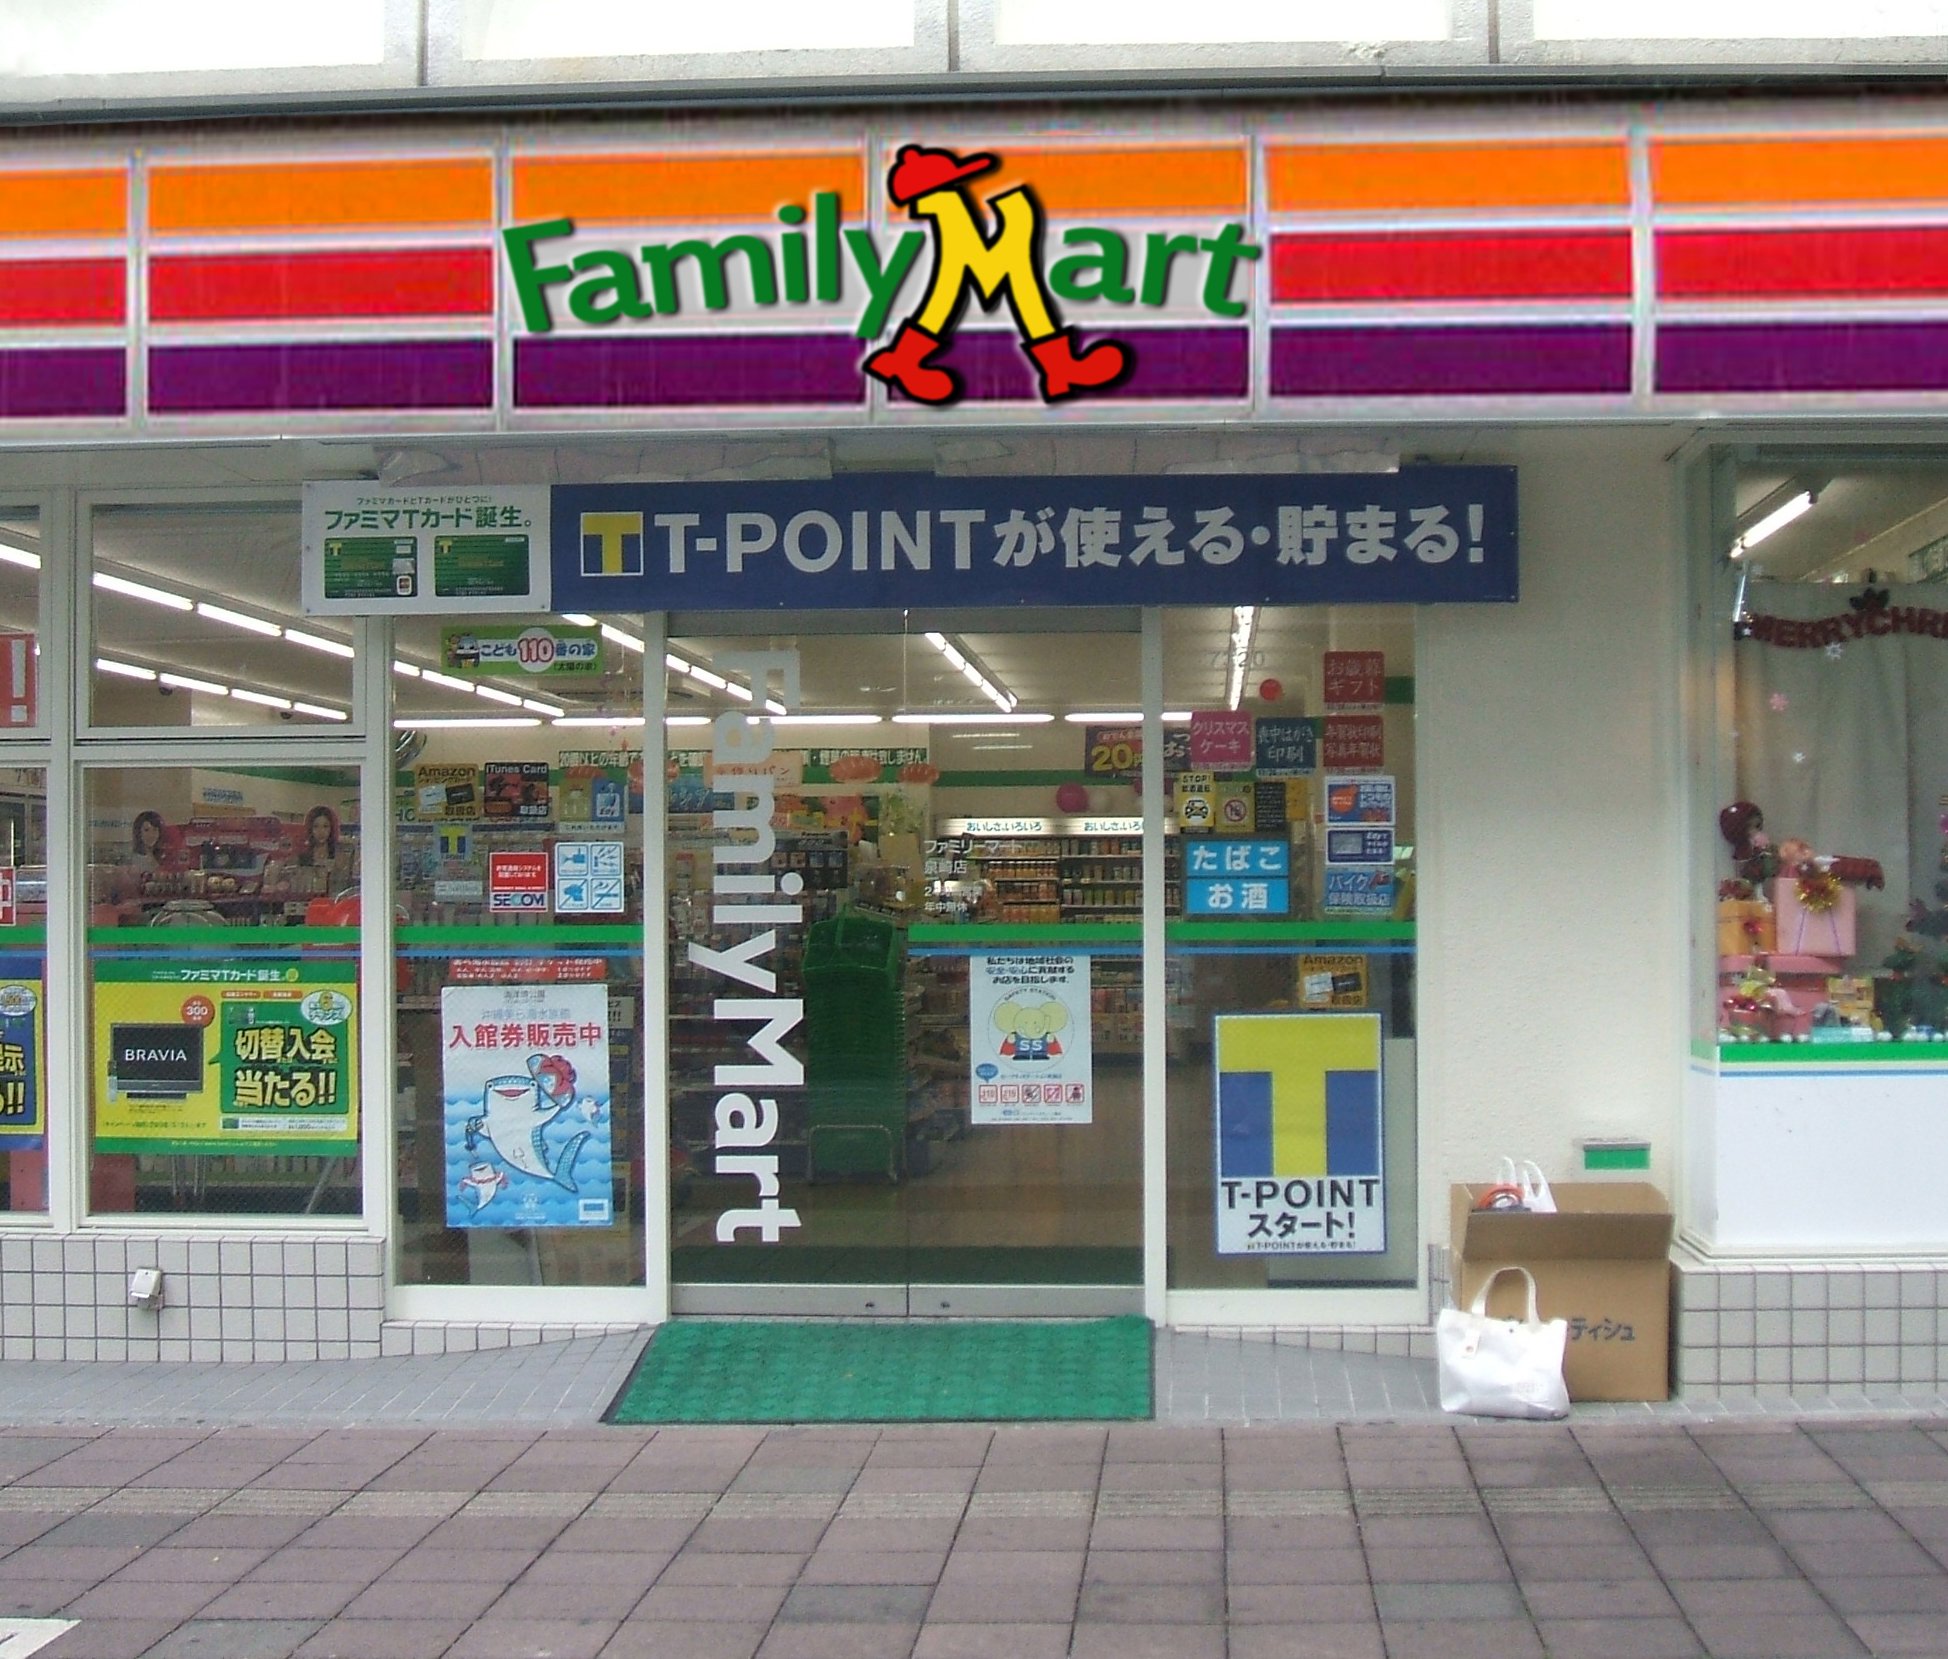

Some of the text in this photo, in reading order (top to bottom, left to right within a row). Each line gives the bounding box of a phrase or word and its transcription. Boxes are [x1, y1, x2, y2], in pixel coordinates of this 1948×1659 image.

[502, 165, 1260, 385] FamilyMart
[1327, 678, 1379, 696] ギフト
[1192, 721, 1250, 736] クリスマス
[1200, 739, 1241, 754] ケーキ
[418, 767, 477, 777] Amazon
[523, 766, 547, 774] Card
[924, 839, 1023, 854] ファミリーマート
[1193, 844, 1282, 871] たばこ
[1328, 873, 1369, 891] バイク
[493, 893, 545, 907] SECOM
[1208, 882, 1269, 910] お酒
[688, 651, 804, 1243] FamilyMart
[1303, 955, 1364, 966] Amazon
[450, 1022, 602, 1048] 入館券販売中
[235, 1027, 338, 1063] 切替入会
[125, 1048, 188, 1062] BRAVIA
[1221, 1179, 1380, 1210] T-POINT
[1248, 1212, 1355, 1240] スタート!
[1571, 1317, 1635, 1342] ティシュ
